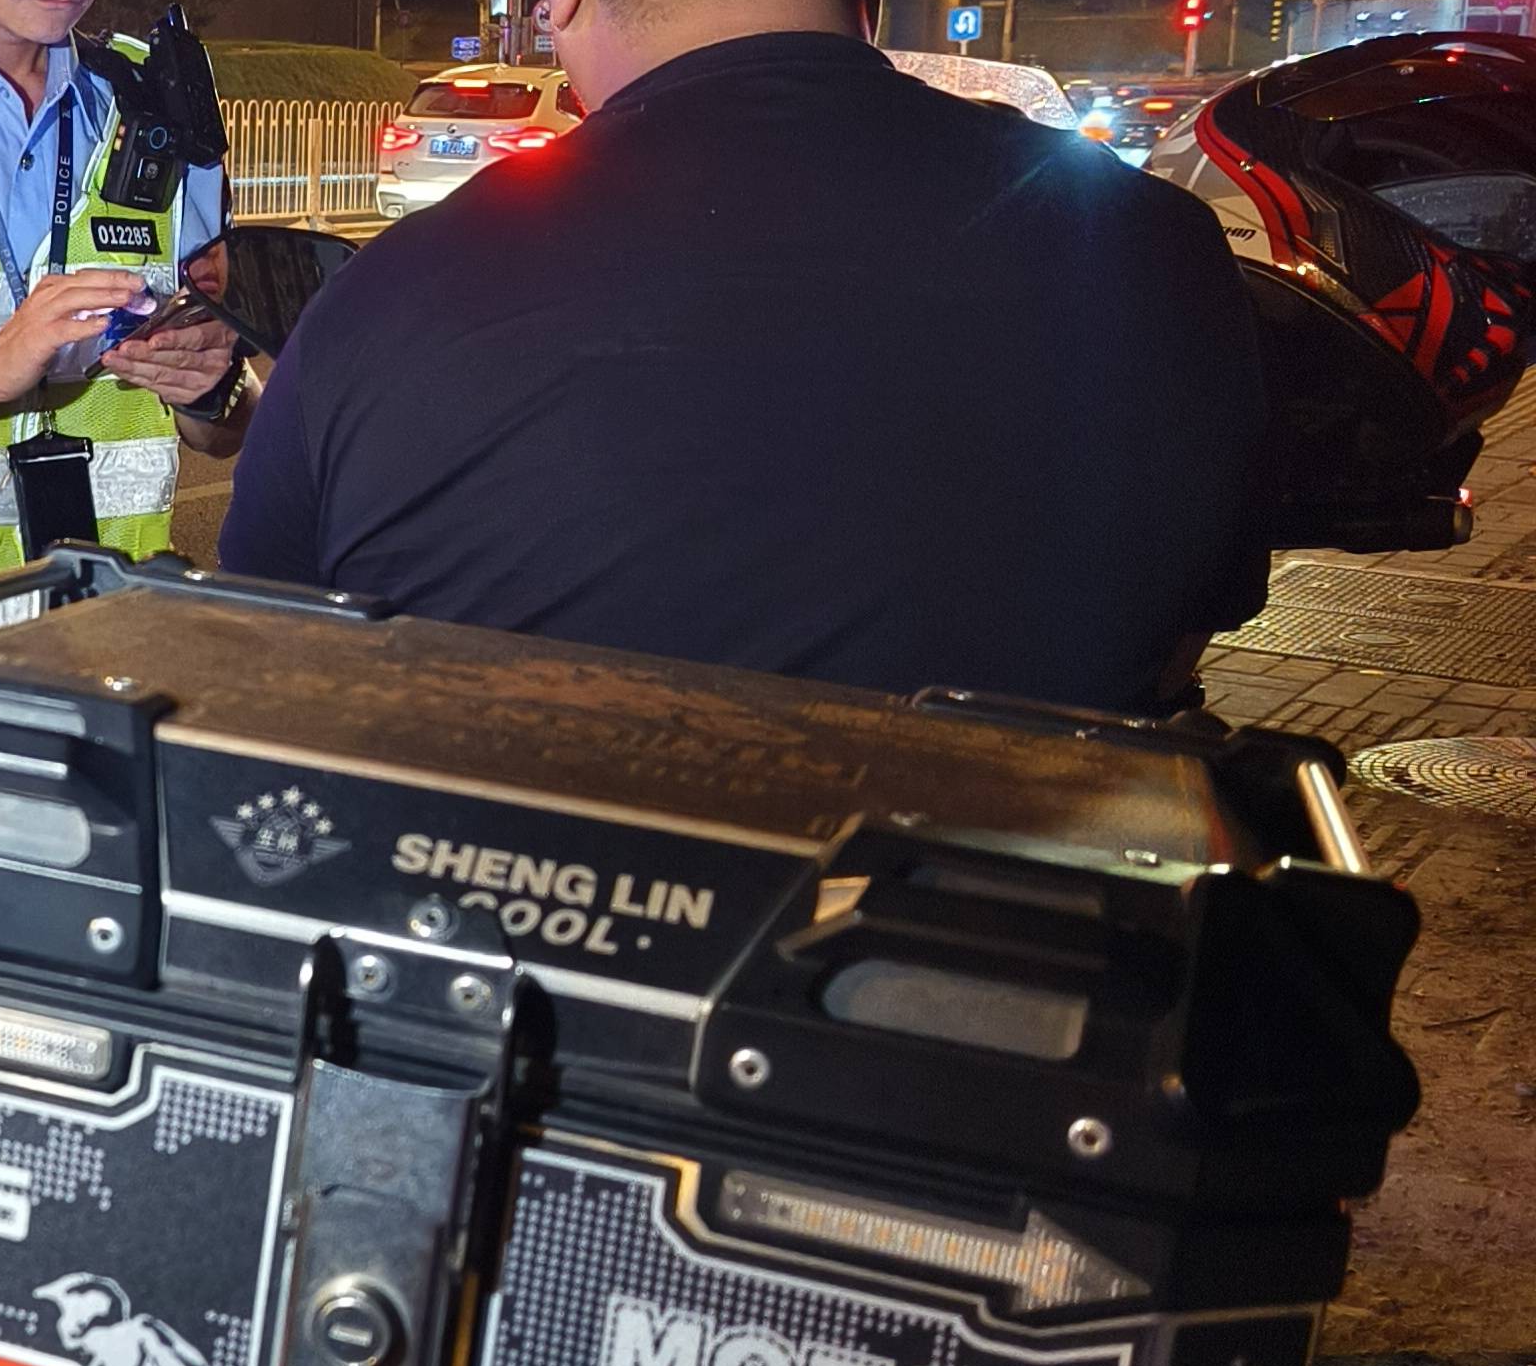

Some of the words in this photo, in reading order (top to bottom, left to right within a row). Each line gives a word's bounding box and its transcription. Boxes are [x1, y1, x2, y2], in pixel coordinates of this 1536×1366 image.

[54, 155, 71, 225] POLICE
[97, 224, 151, 247] 012285
[391, 833, 599, 909] SHENG
[609, 873, 714, 930] LIN
